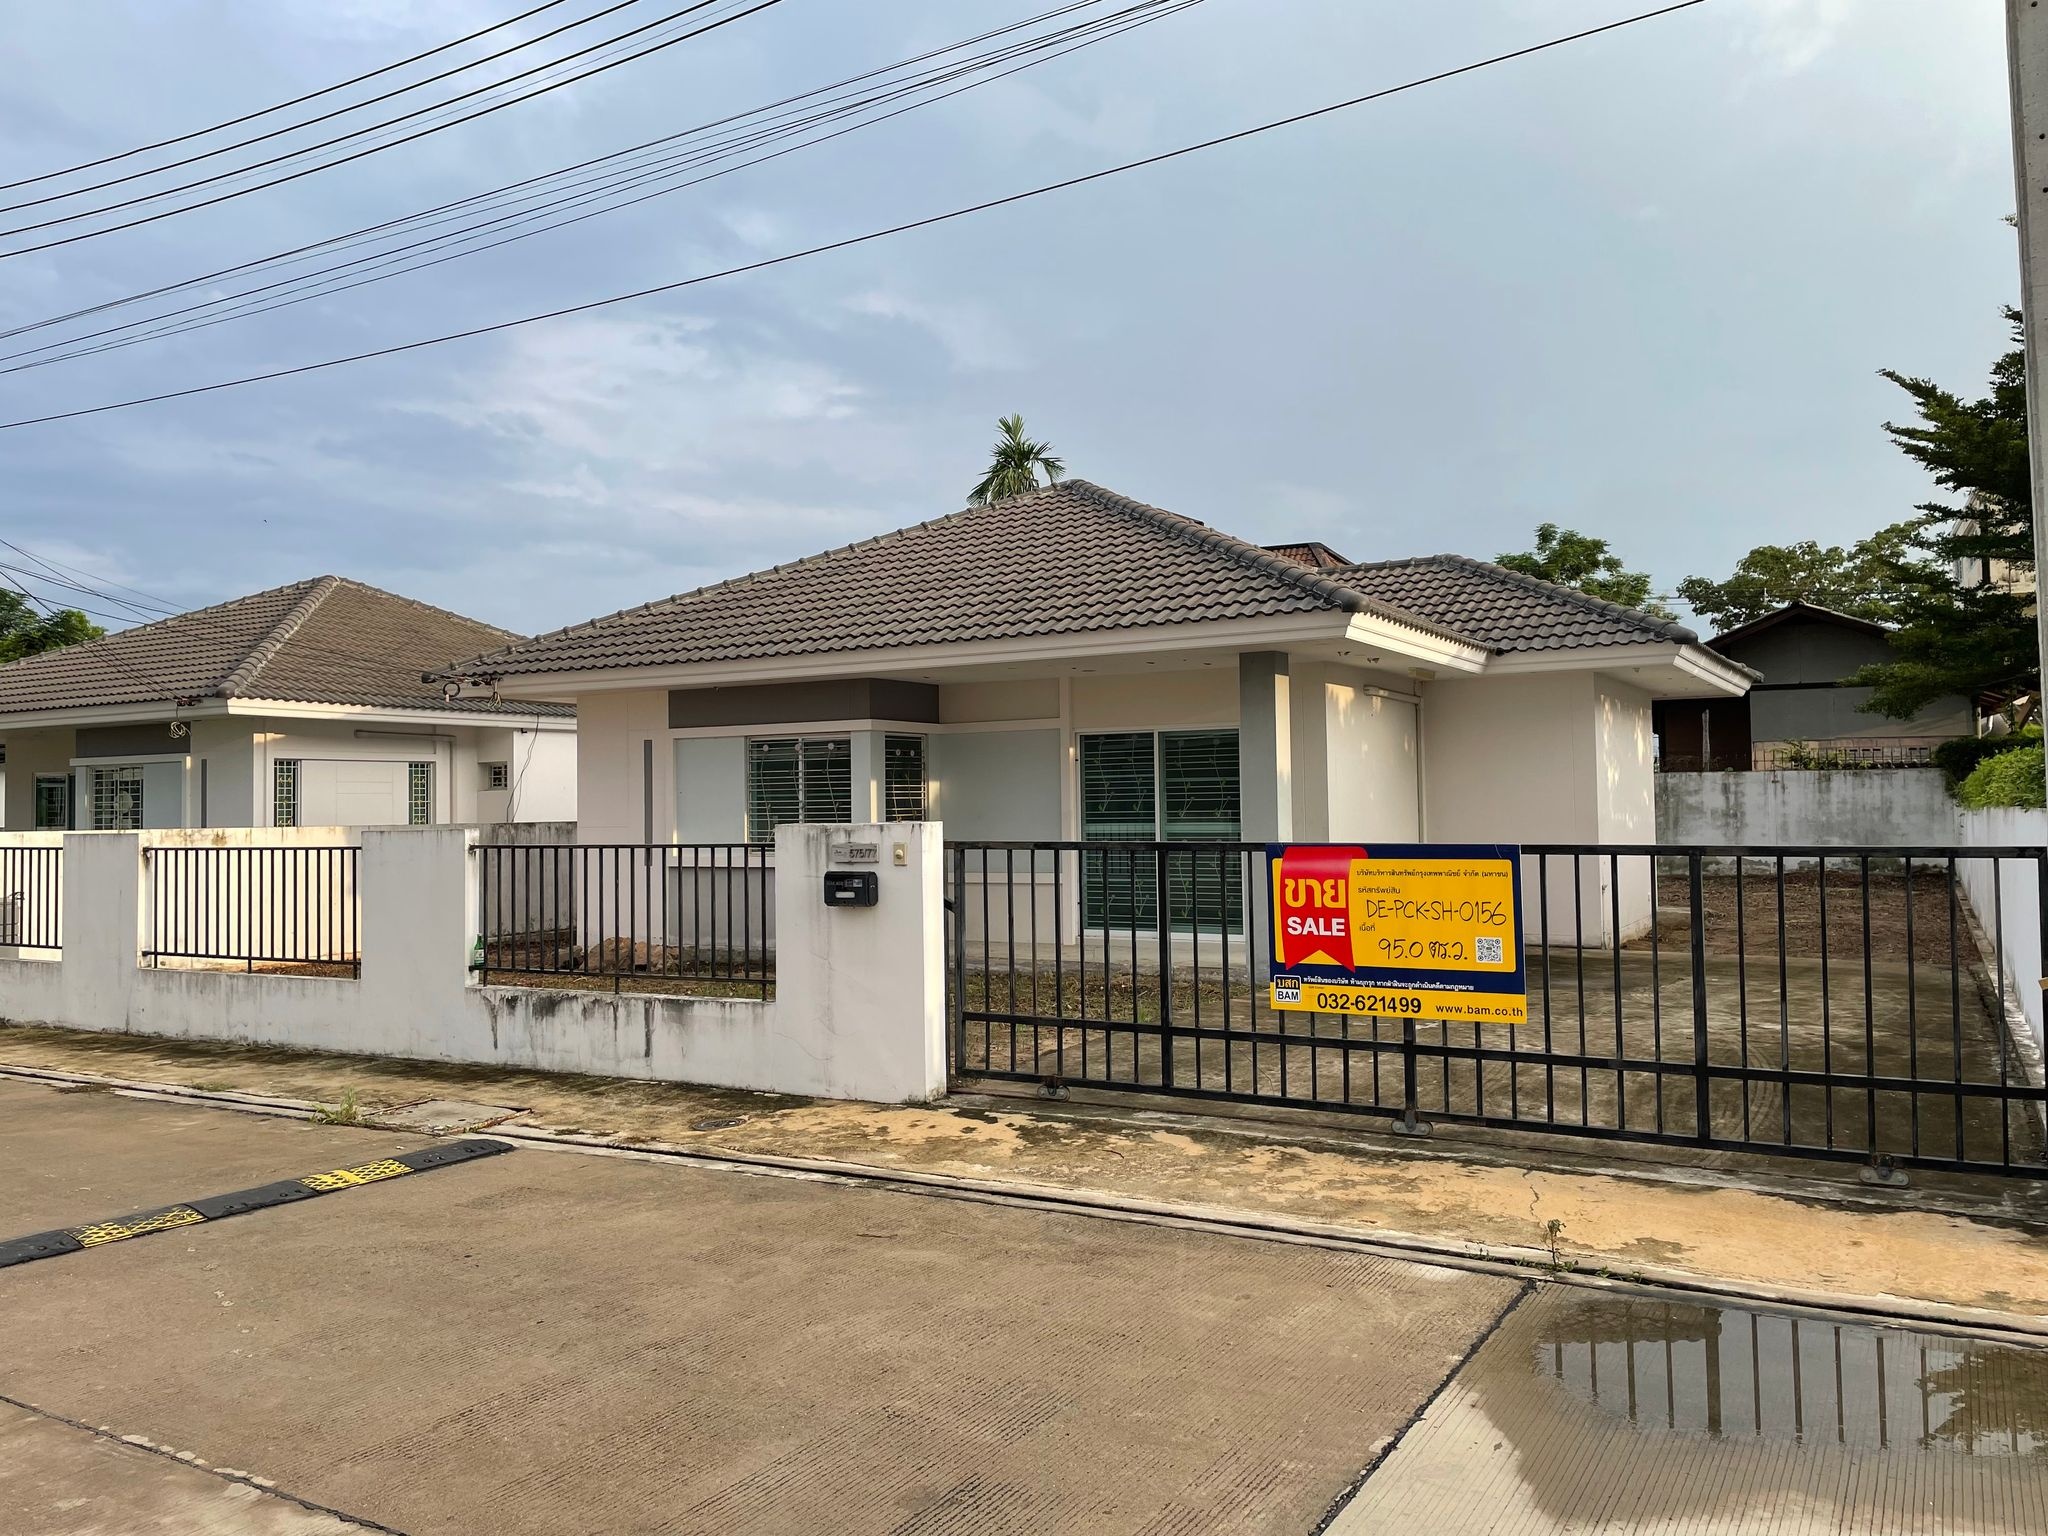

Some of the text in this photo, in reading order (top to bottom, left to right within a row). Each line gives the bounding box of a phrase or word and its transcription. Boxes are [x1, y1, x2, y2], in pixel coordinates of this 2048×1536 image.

[1463, 869, 1480, 877] จำกัด
[1481, 871, 1509, 879] (มหาชน)
[1284, 878, 1347, 909] ขาย
[1357, 886, 1401, 894] รหัสทรัพย์สิน
[1366, 899, 1507, 926] DE-PCK-SH-0156
[1287, 916, 1346, 937] SALE
[1359, 921, 1376, 932] เนื้อที่
[1378, 938, 1424, 960] 95.0
[1277, 978, 1299, 989] บสก
[1277, 990, 1299, 1001] BAM
[1317, 992, 1523, 1017] 032-621499 www.bam.co.th
